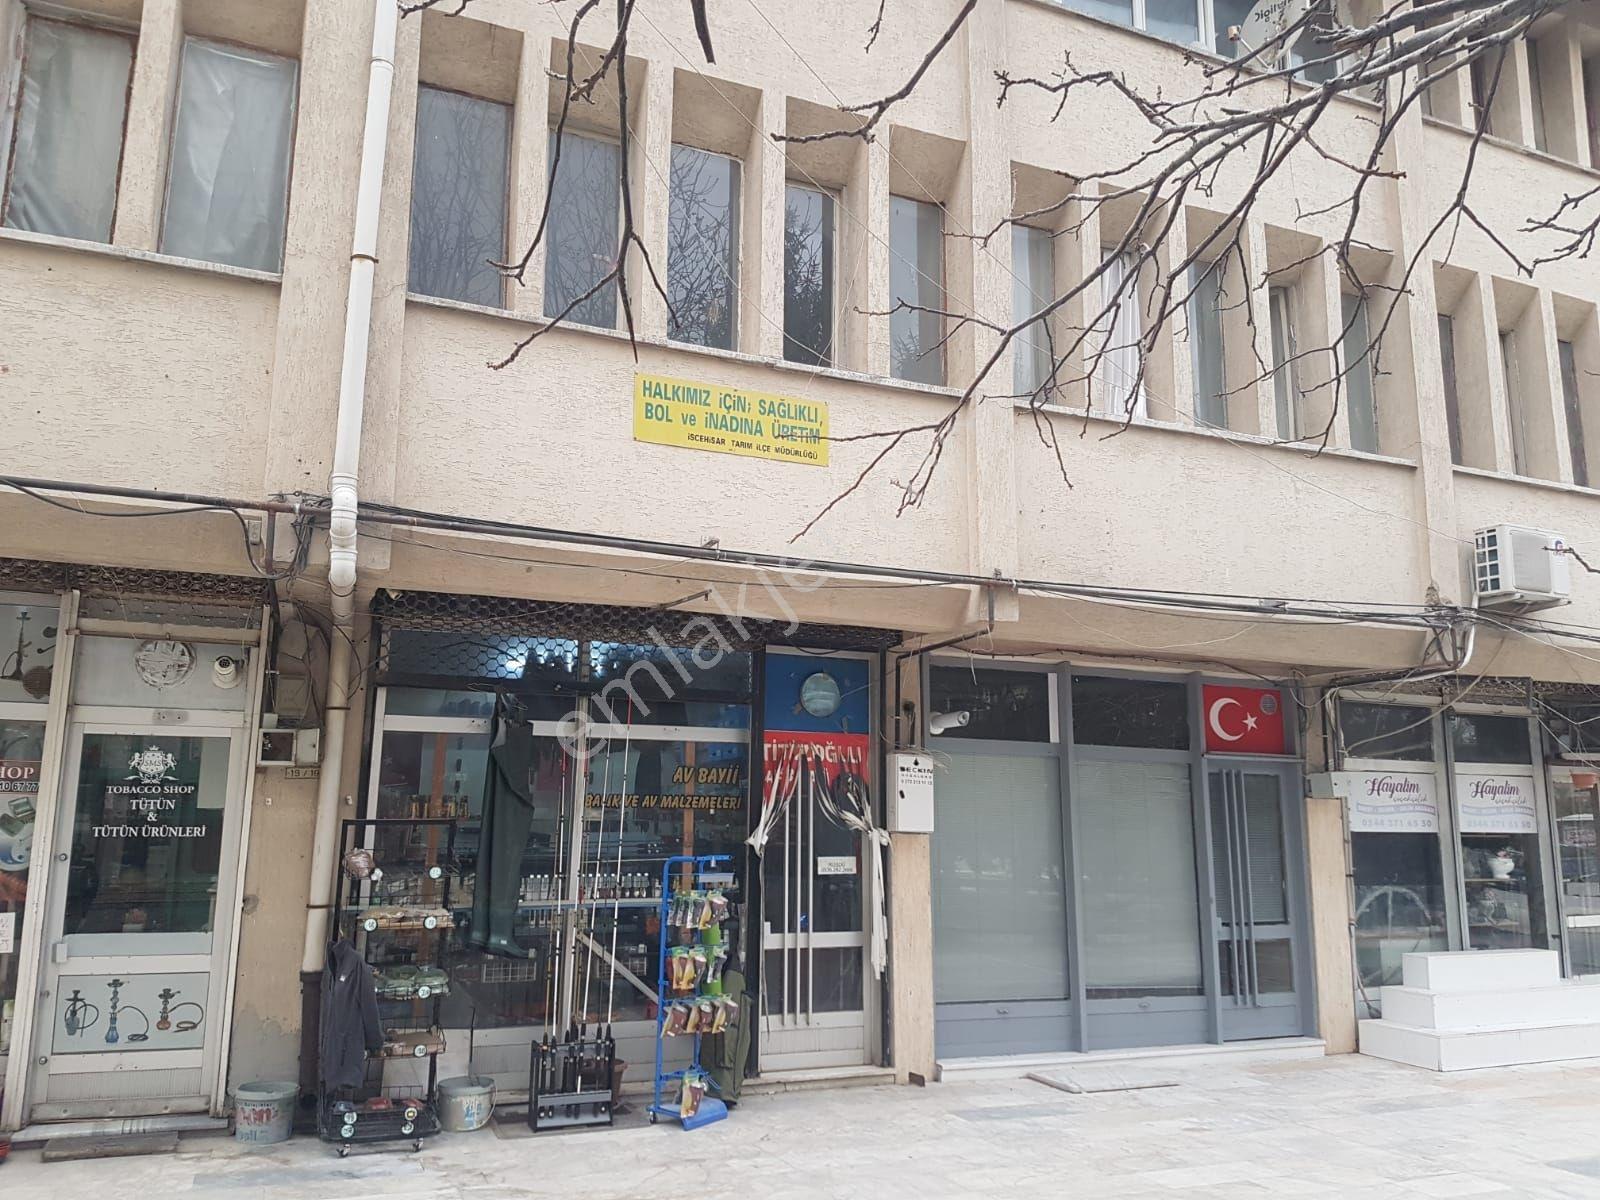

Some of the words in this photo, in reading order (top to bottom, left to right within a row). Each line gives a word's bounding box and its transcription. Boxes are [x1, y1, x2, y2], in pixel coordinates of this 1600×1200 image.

[642, 380, 711, 407] HALKIMIZ
[644, 402, 673, 423] BOL
[681, 413, 697, 426] ve
[731, 439, 753, 450] TARIM
[756, 443, 771, 454] İLÇE
[673, 766, 695, 784] AV
[106, 785, 161, 794] TOBACCO
[163, 786, 195, 794] SHOP
[129, 797, 176, 811] TÜTÜN
[624, 795, 640, 808] VE
[641, 795, 658, 808] AV
[147, 811, 158, 822] &
[92, 825, 138, 837] TÜTÜN
[141, 824, 206, 838] ÜRÜNLERİ
